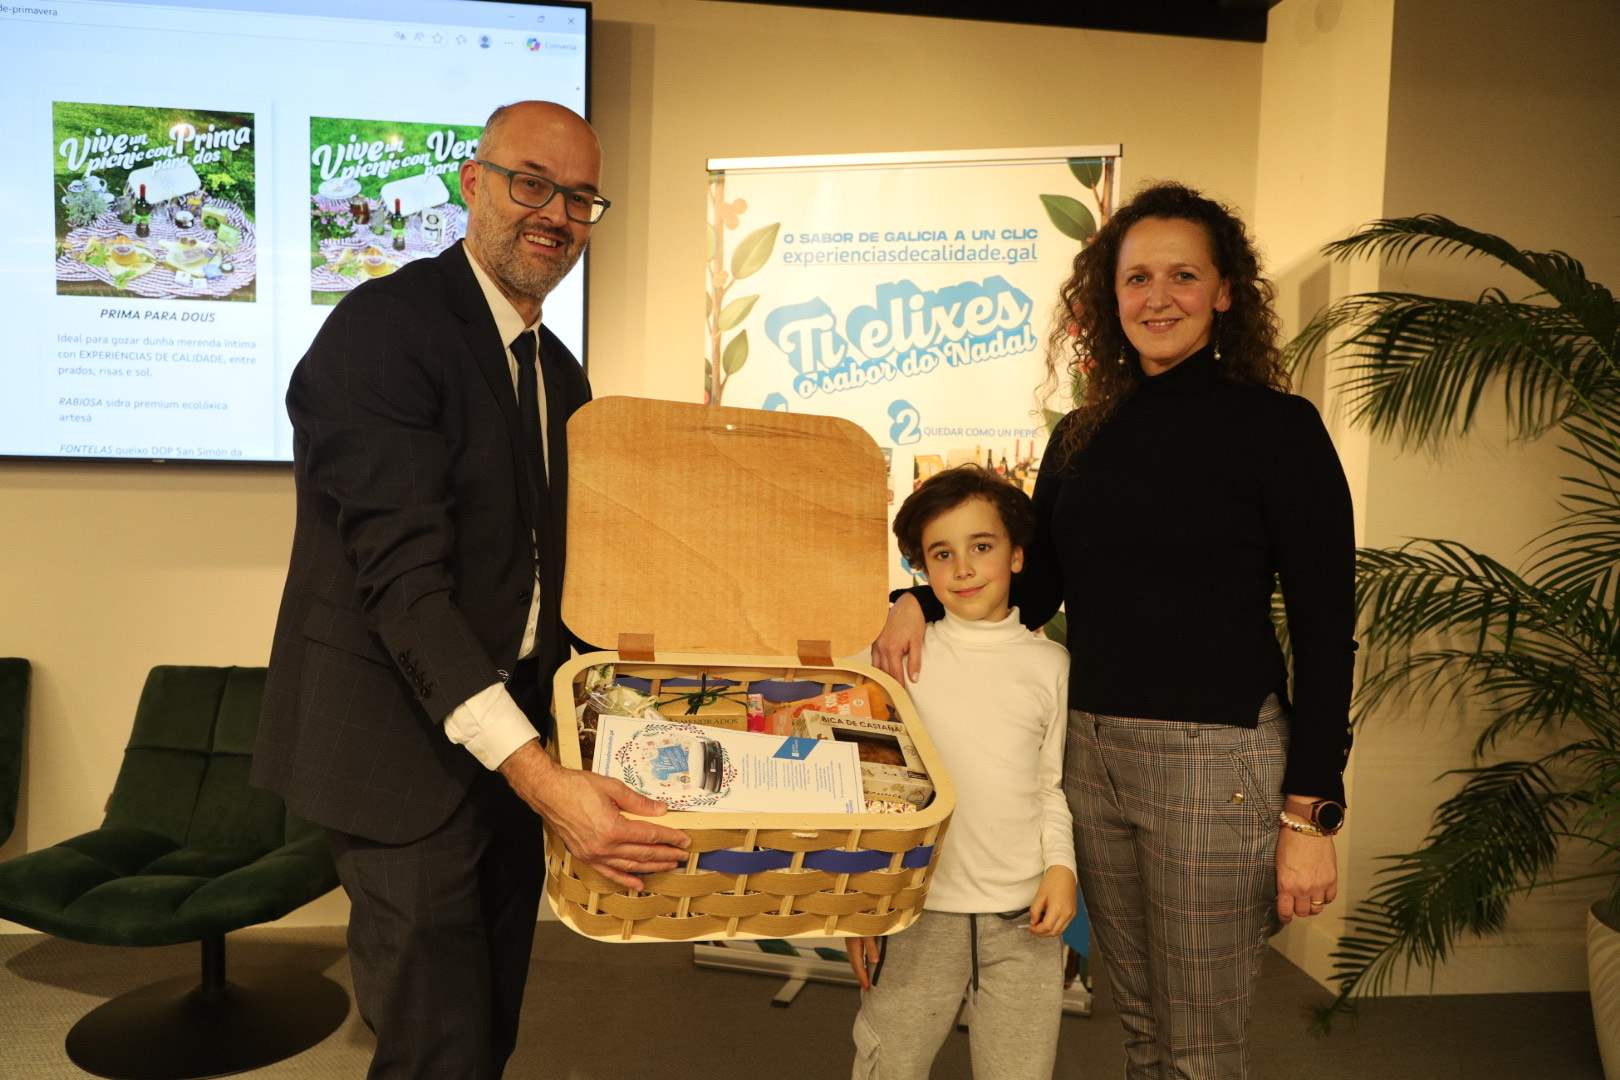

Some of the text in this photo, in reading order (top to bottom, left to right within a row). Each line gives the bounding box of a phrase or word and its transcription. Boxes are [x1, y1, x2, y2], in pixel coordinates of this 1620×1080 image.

[59, 128, 149, 172] Vive un
[84, 123, 251, 180] picnic con Prima
[312, 134, 384, 181] Vive
[151, 148, 221, 177] para dos
[340, 153, 400, 187] picnic
[401, 152, 432, 167] con
[424, 161, 460, 181] para
[784, 228, 1038, 244] O SABOR DE GALICIA A UN CLIC
[783, 243, 1038, 267] experienciasdecalidade.gal
[100, 309, 215, 323] PRIMA PARA DOUS
[771, 281, 1033, 374] Ti elixes
[57, 334, 82, 343] Ideal
[86, 336, 109, 345] para
[111, 337, 139, 347] gozar
[143, 336, 174, 346] dunha
[177, 338, 221, 348] merenda
[57, 350, 256, 365] con EXPERIENCIAS DE CALIDADE, entre
[796, 324, 1037, 398] o sabor do Nadal
[58, 366, 96, 376] prados,
[99, 367, 123, 376] risas
[135, 368, 153, 377] sol.
[58, 397, 228, 410] RABIOSA sidra premium ecolóxica
[890, 403, 1037, 445] 2 QUEDAR COMO UN PEPE
[59, 444, 113, 455] FONTELAS
[115, 446, 149, 455] queixo
[151, 446, 173, 456] DOP
[176, 447, 194, 456] San
[230, 448, 243, 457] da
[821, 716, 844, 725] BICA
[846, 719, 858, 727] DE
